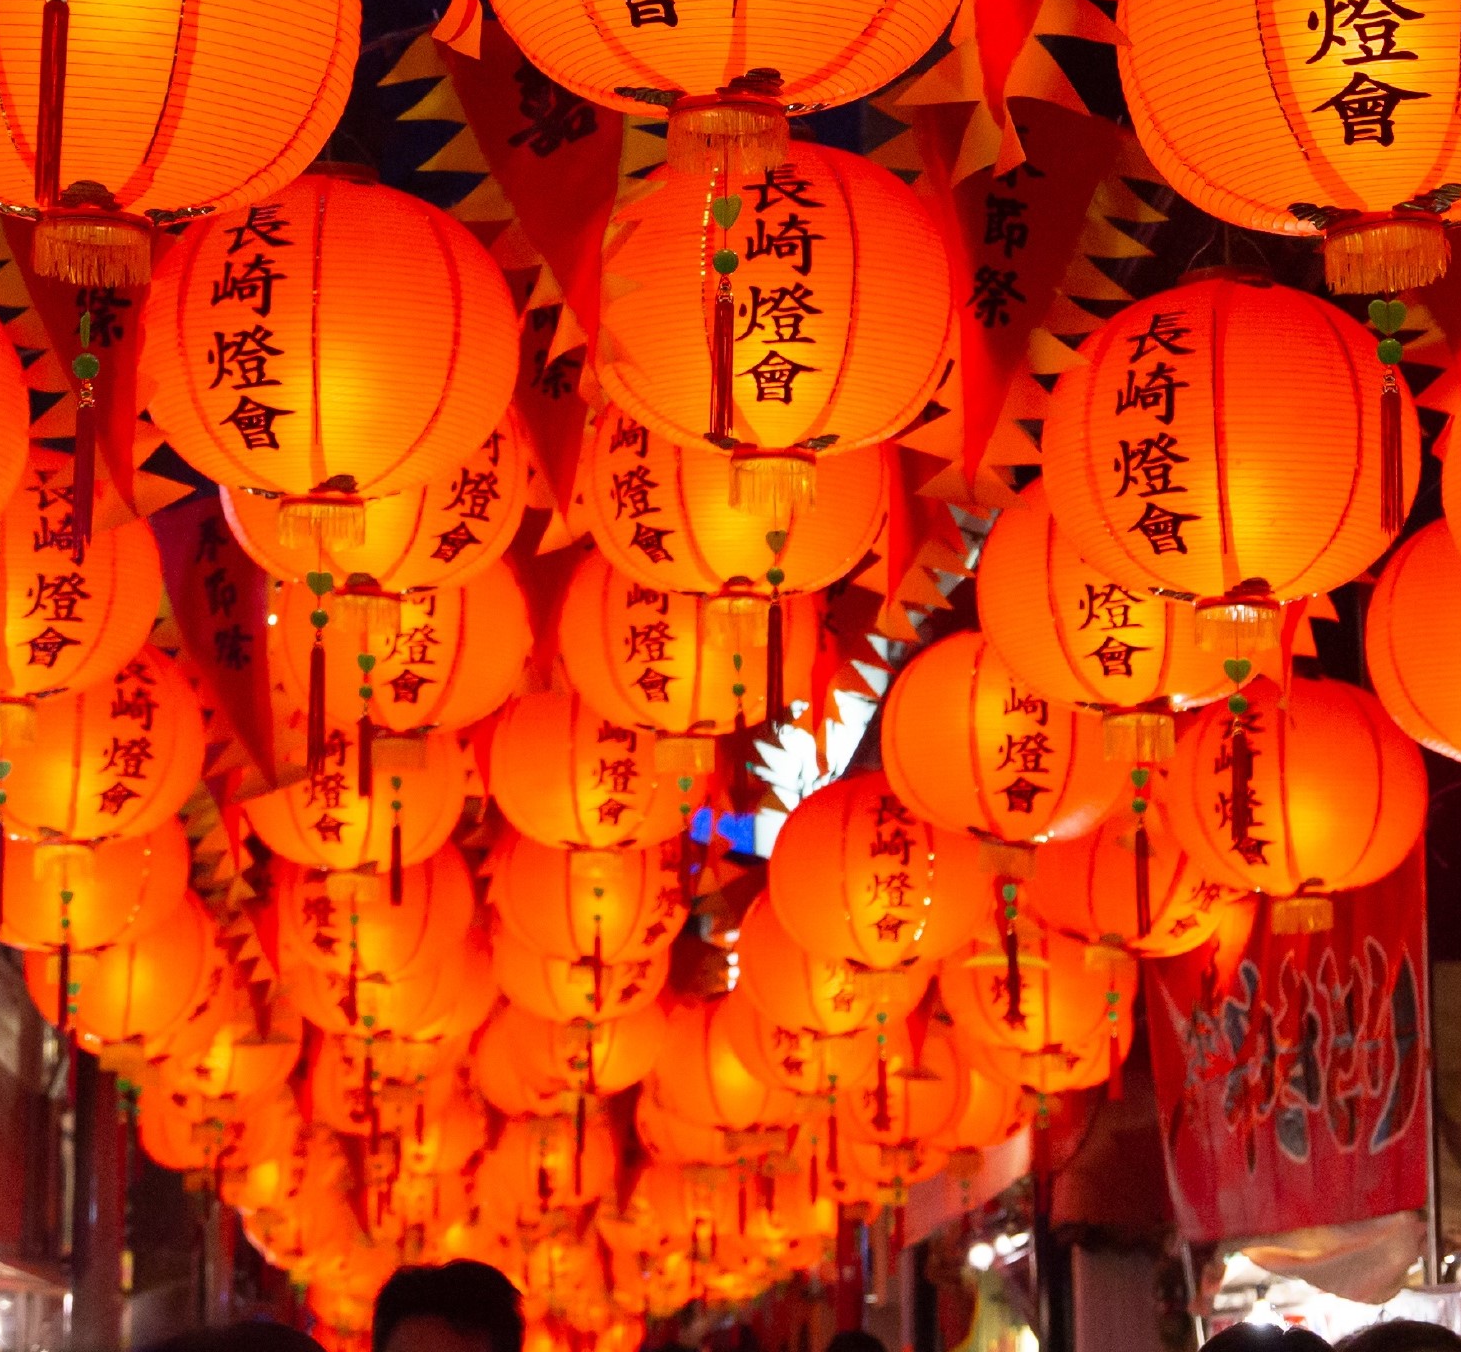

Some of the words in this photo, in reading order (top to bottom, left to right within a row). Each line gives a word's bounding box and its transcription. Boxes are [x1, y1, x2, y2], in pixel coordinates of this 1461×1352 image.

[208, 204, 295, 450] 長崎燈會
[735, 163, 826, 404] 長崎燈會
[430, 429, 506, 564] 燈會
[1113, 311, 1202, 556] 長崎燈會
[1078, 582, 1154, 679] 燈會
